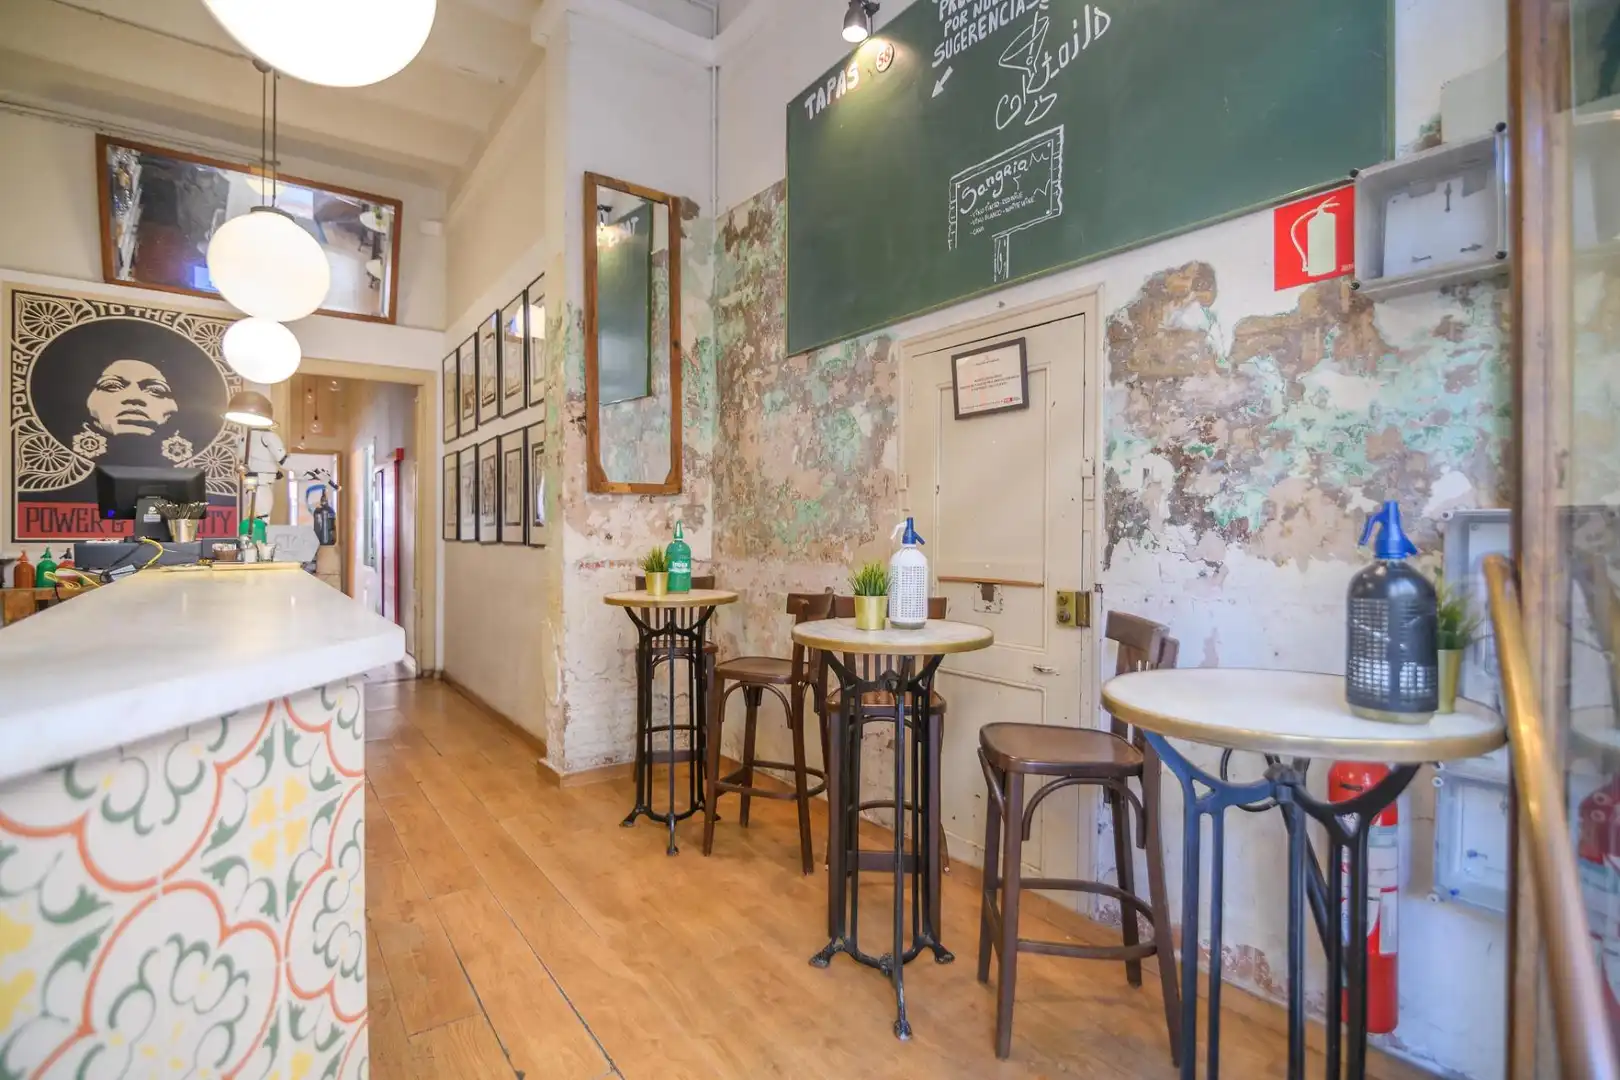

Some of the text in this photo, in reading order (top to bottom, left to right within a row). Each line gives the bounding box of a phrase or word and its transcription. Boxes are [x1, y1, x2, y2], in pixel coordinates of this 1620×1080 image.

[944, 9, 968, 37] POR
[804, 60, 859, 120] TAPAS
[91, 301, 178, 325] TO THE
[12, 350, 32, 420] POWER
[24, 507, 104, 533] POWER
